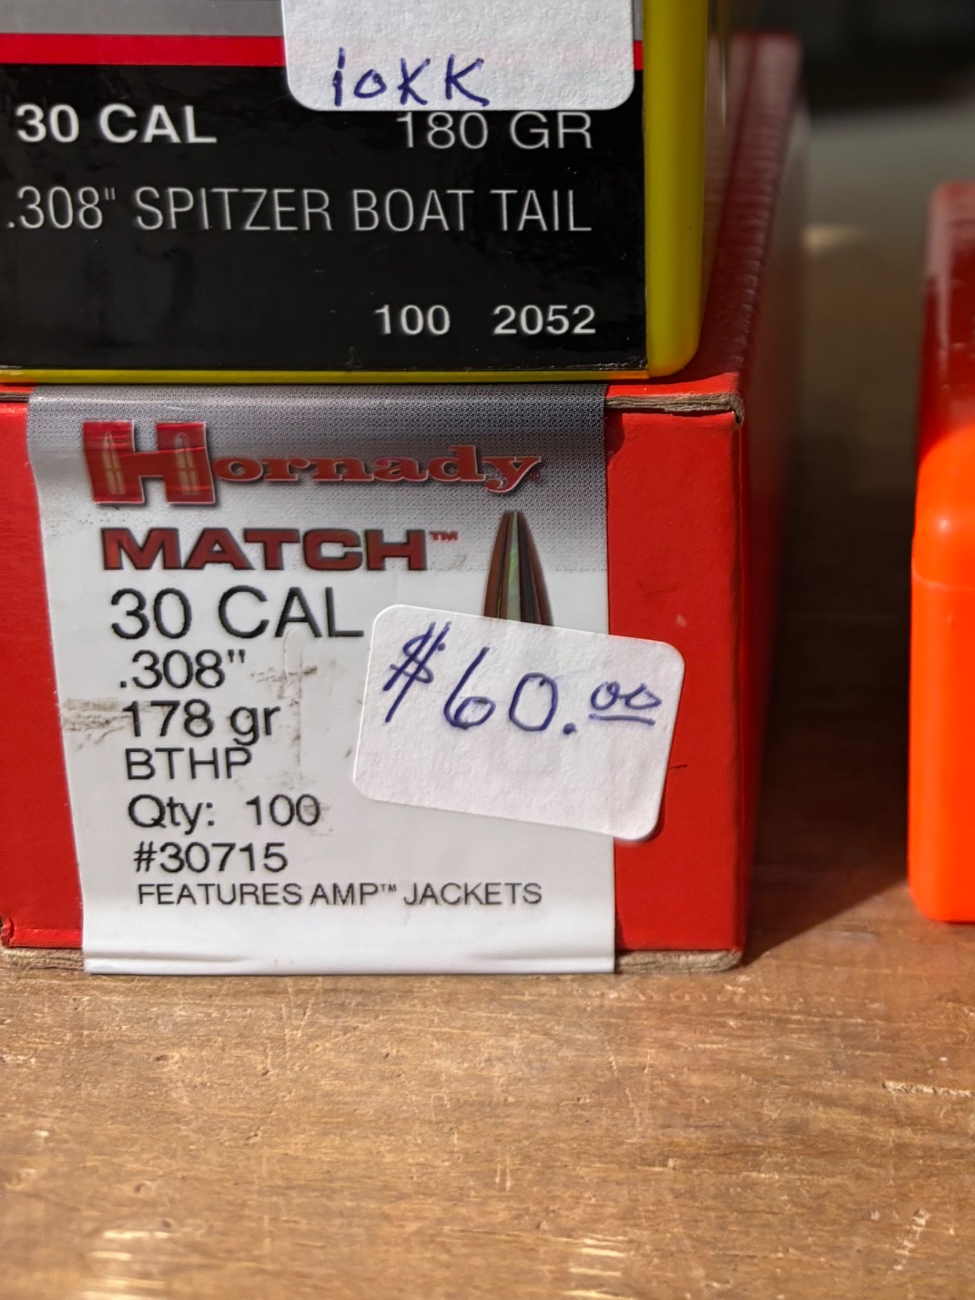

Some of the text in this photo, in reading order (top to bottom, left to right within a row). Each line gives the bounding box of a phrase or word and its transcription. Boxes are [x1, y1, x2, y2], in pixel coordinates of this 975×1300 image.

[15, 103, 593, 150] 30 CAL 180 GR
[7, 186, 593, 232] .308" SPITZER BOAT TAIL
[374, 303, 597, 336] 100 2052
[82, 419, 543, 505] Hornady
[110, 585, 365, 640] 30 CAL
[119, 649, 247, 689] .308"
[122, 699, 282, 747] 178 gr
[125, 746, 253, 780] BTHP
[128, 793, 321, 835] Qty: 100
[133, 840, 288, 873] #30715
[138, 882, 301, 906] FEATURES
[403, 882, 543, 906] JACKETS
